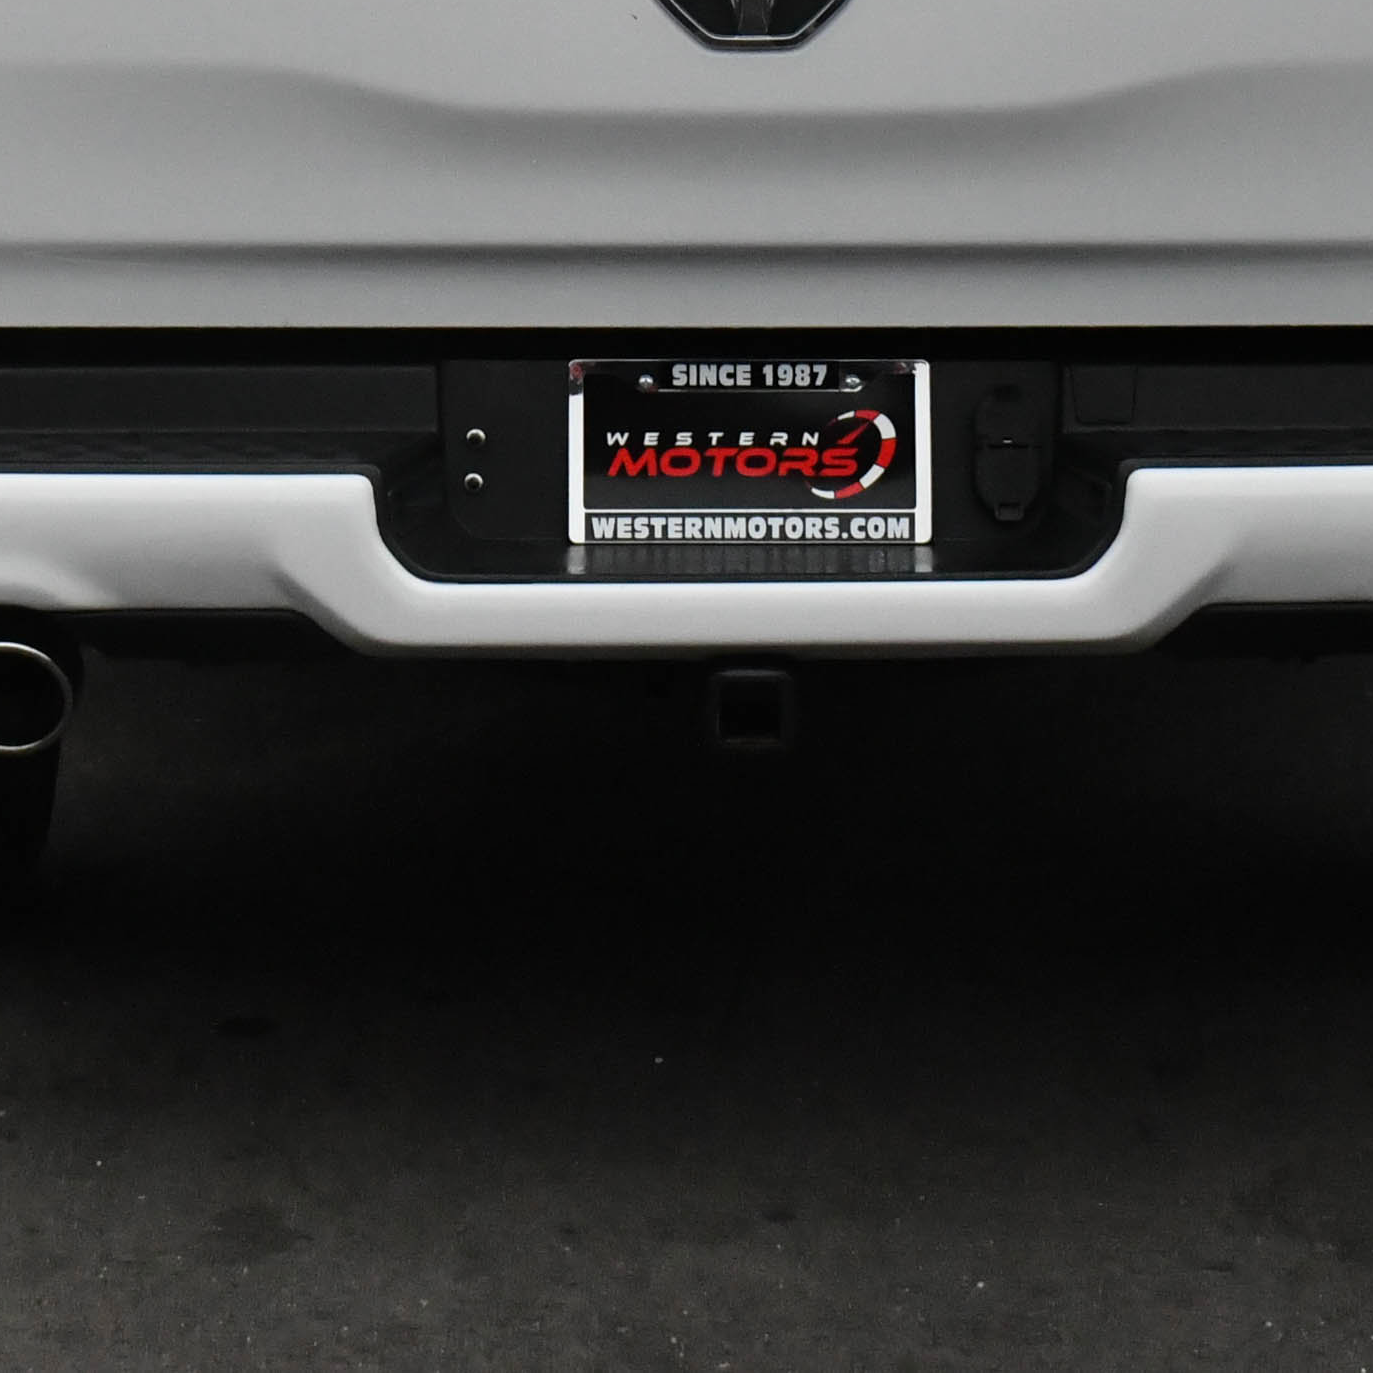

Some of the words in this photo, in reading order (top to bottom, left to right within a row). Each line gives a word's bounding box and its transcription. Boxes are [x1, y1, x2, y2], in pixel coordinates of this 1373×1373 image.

[672, 364, 751, 386] SINCE
[763, 364, 827, 386] 1987
[606, 432, 819, 446] WESTERN
[607, 447, 858, 477] MOTORS
[592, 517, 909, 539] WESTERNMOTORS.COM
